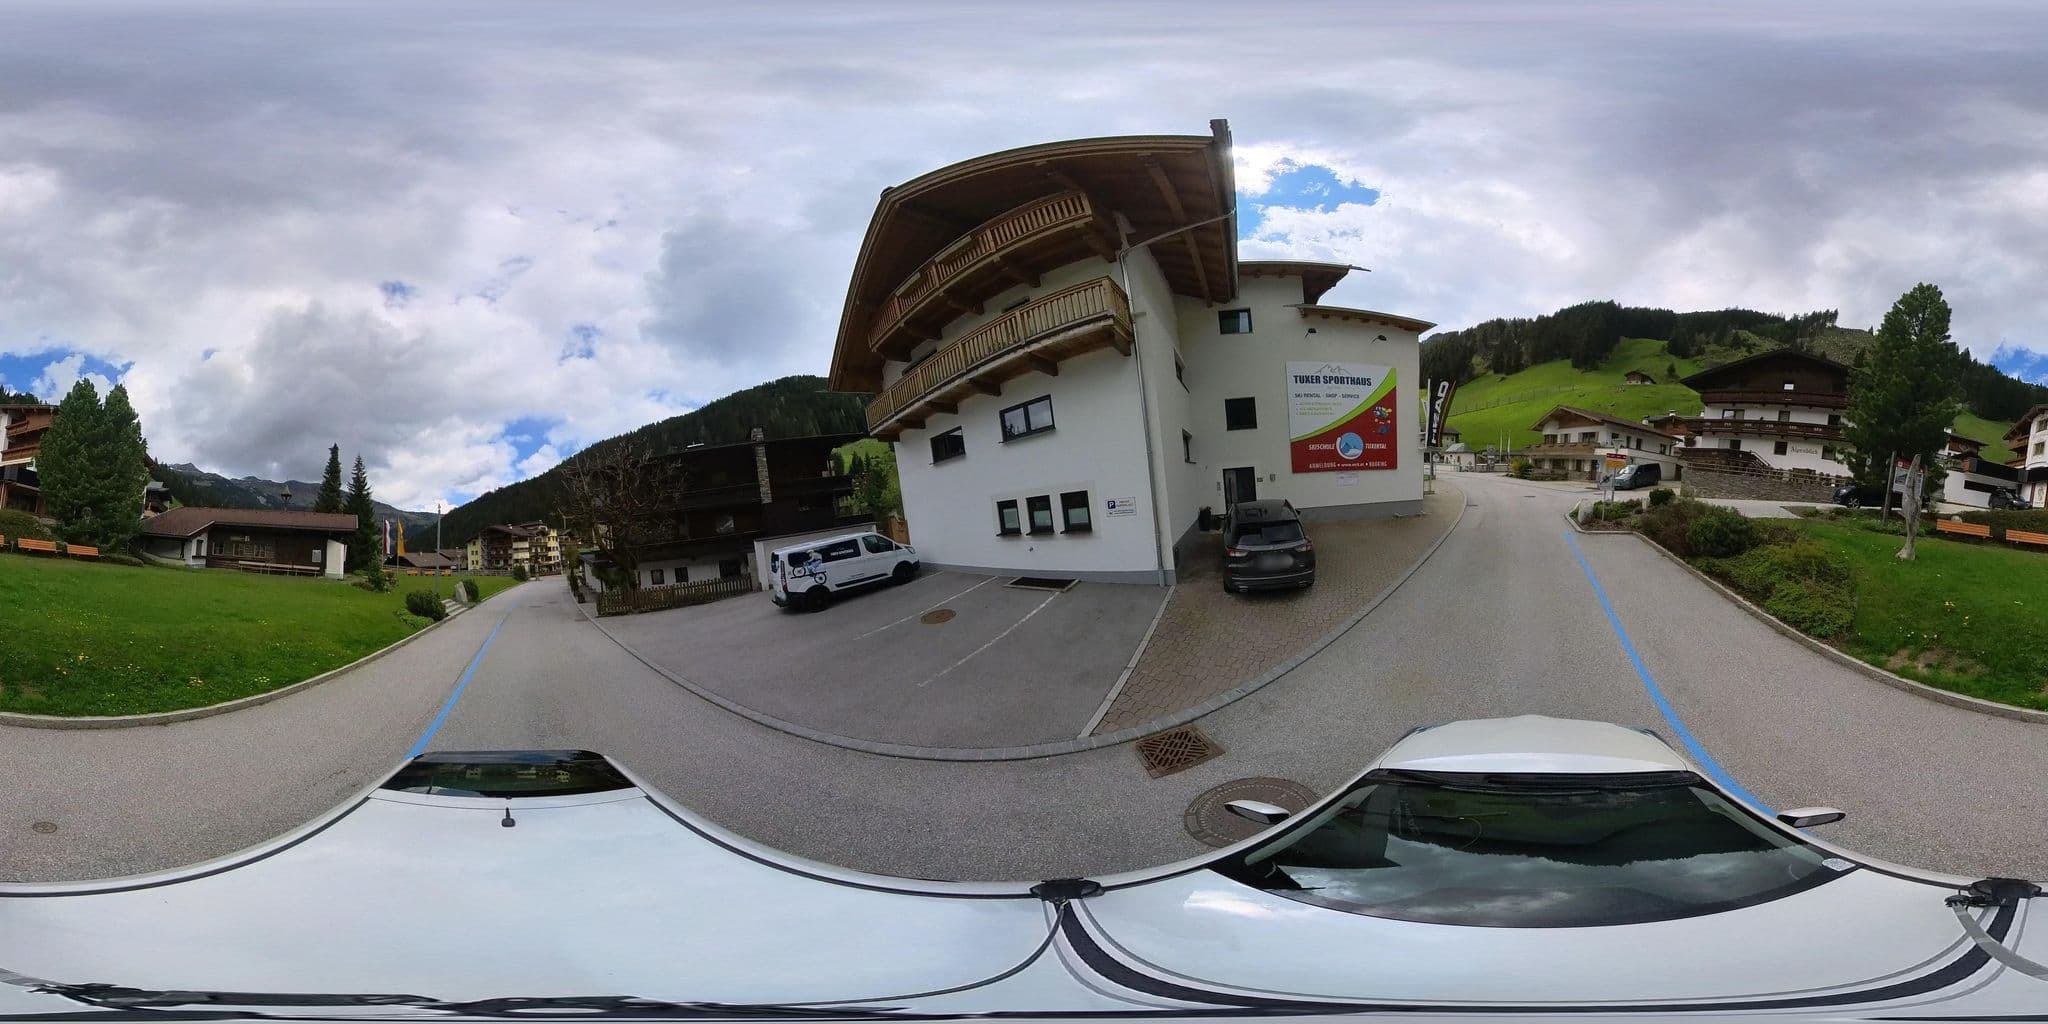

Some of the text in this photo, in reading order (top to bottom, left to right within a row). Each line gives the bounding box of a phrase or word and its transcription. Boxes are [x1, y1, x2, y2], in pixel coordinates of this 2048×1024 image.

[1293, 375, 1372, 386] TUXER SPORTHAUS
[1431, 380, 1449, 444] HEAD
